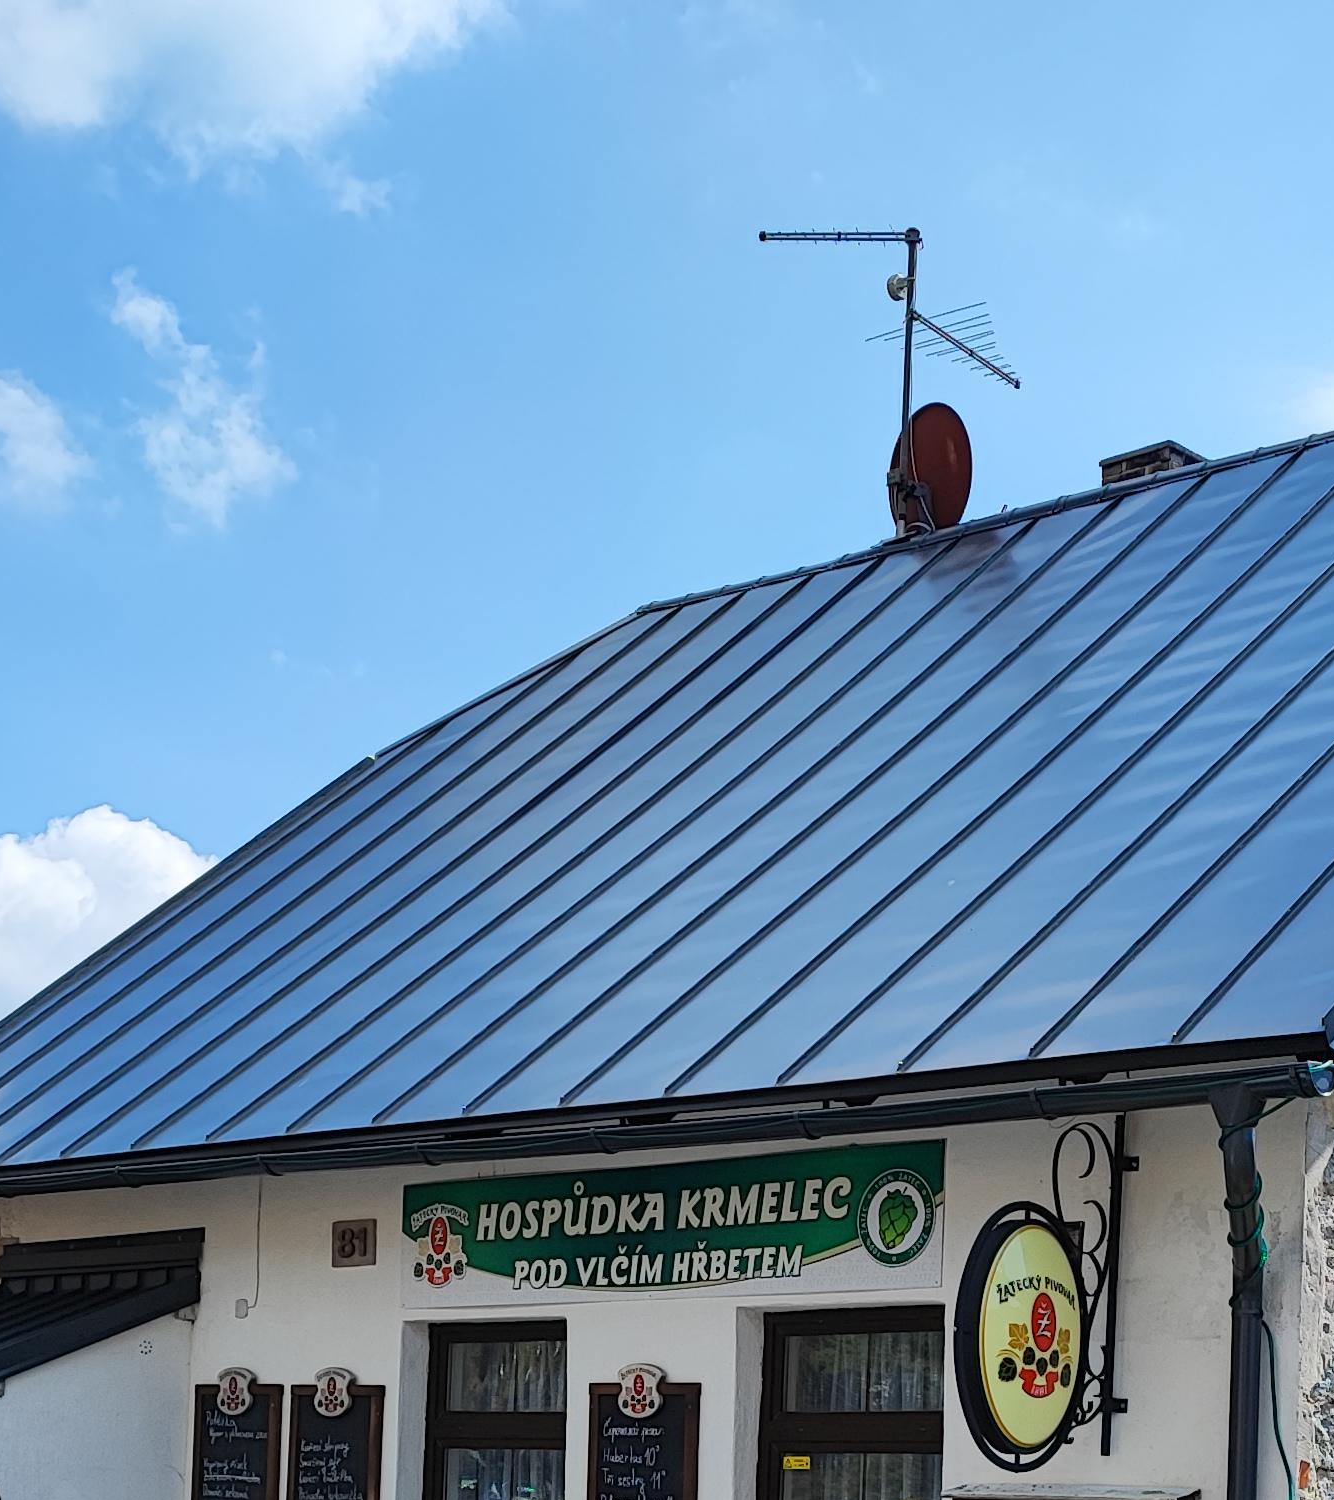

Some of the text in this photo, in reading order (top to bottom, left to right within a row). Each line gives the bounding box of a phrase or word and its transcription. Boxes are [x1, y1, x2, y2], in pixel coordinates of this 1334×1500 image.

[476, 1176, 852, 1241] HOSPŮDKA KRMELEC
[338, 1227, 367, 1258] 81
[513, 1241, 804, 1290] POD VLČÍM HŘBETEM
[996, 1275, 1076, 1311] ŽATECKÝ PIVOVAR
